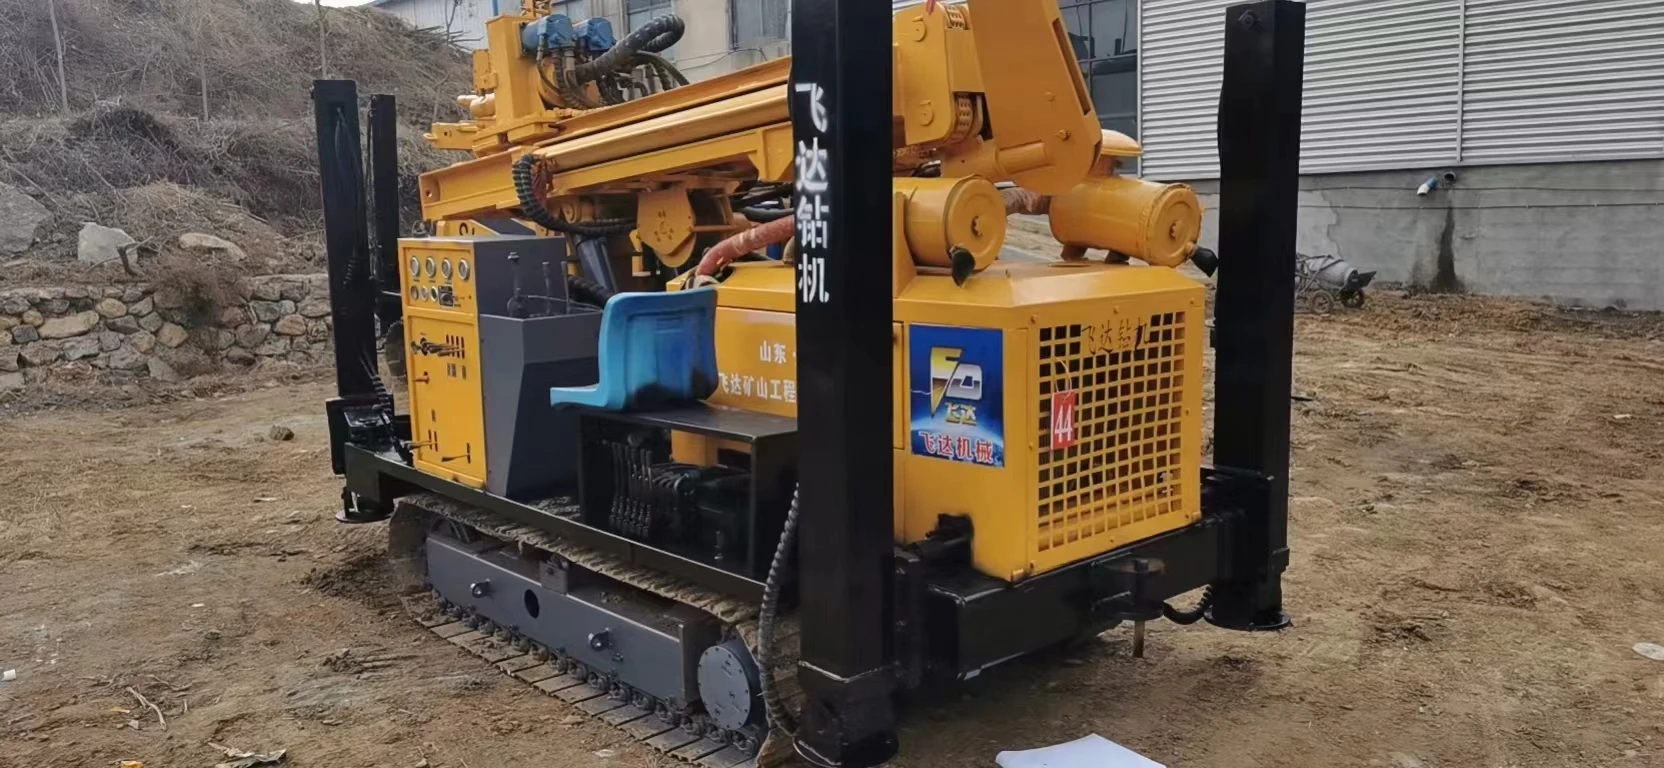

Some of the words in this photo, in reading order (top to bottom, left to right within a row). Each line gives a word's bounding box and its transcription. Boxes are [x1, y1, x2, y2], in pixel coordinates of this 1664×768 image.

[795, 83, 830, 303] 飞达钻机
[1081, 317, 1150, 355] 飞达钻机
[944, 402, 977, 426] 飞达
[1054, 404, 1073, 443] 44
[918, 430, 994, 464] 飞达机械
